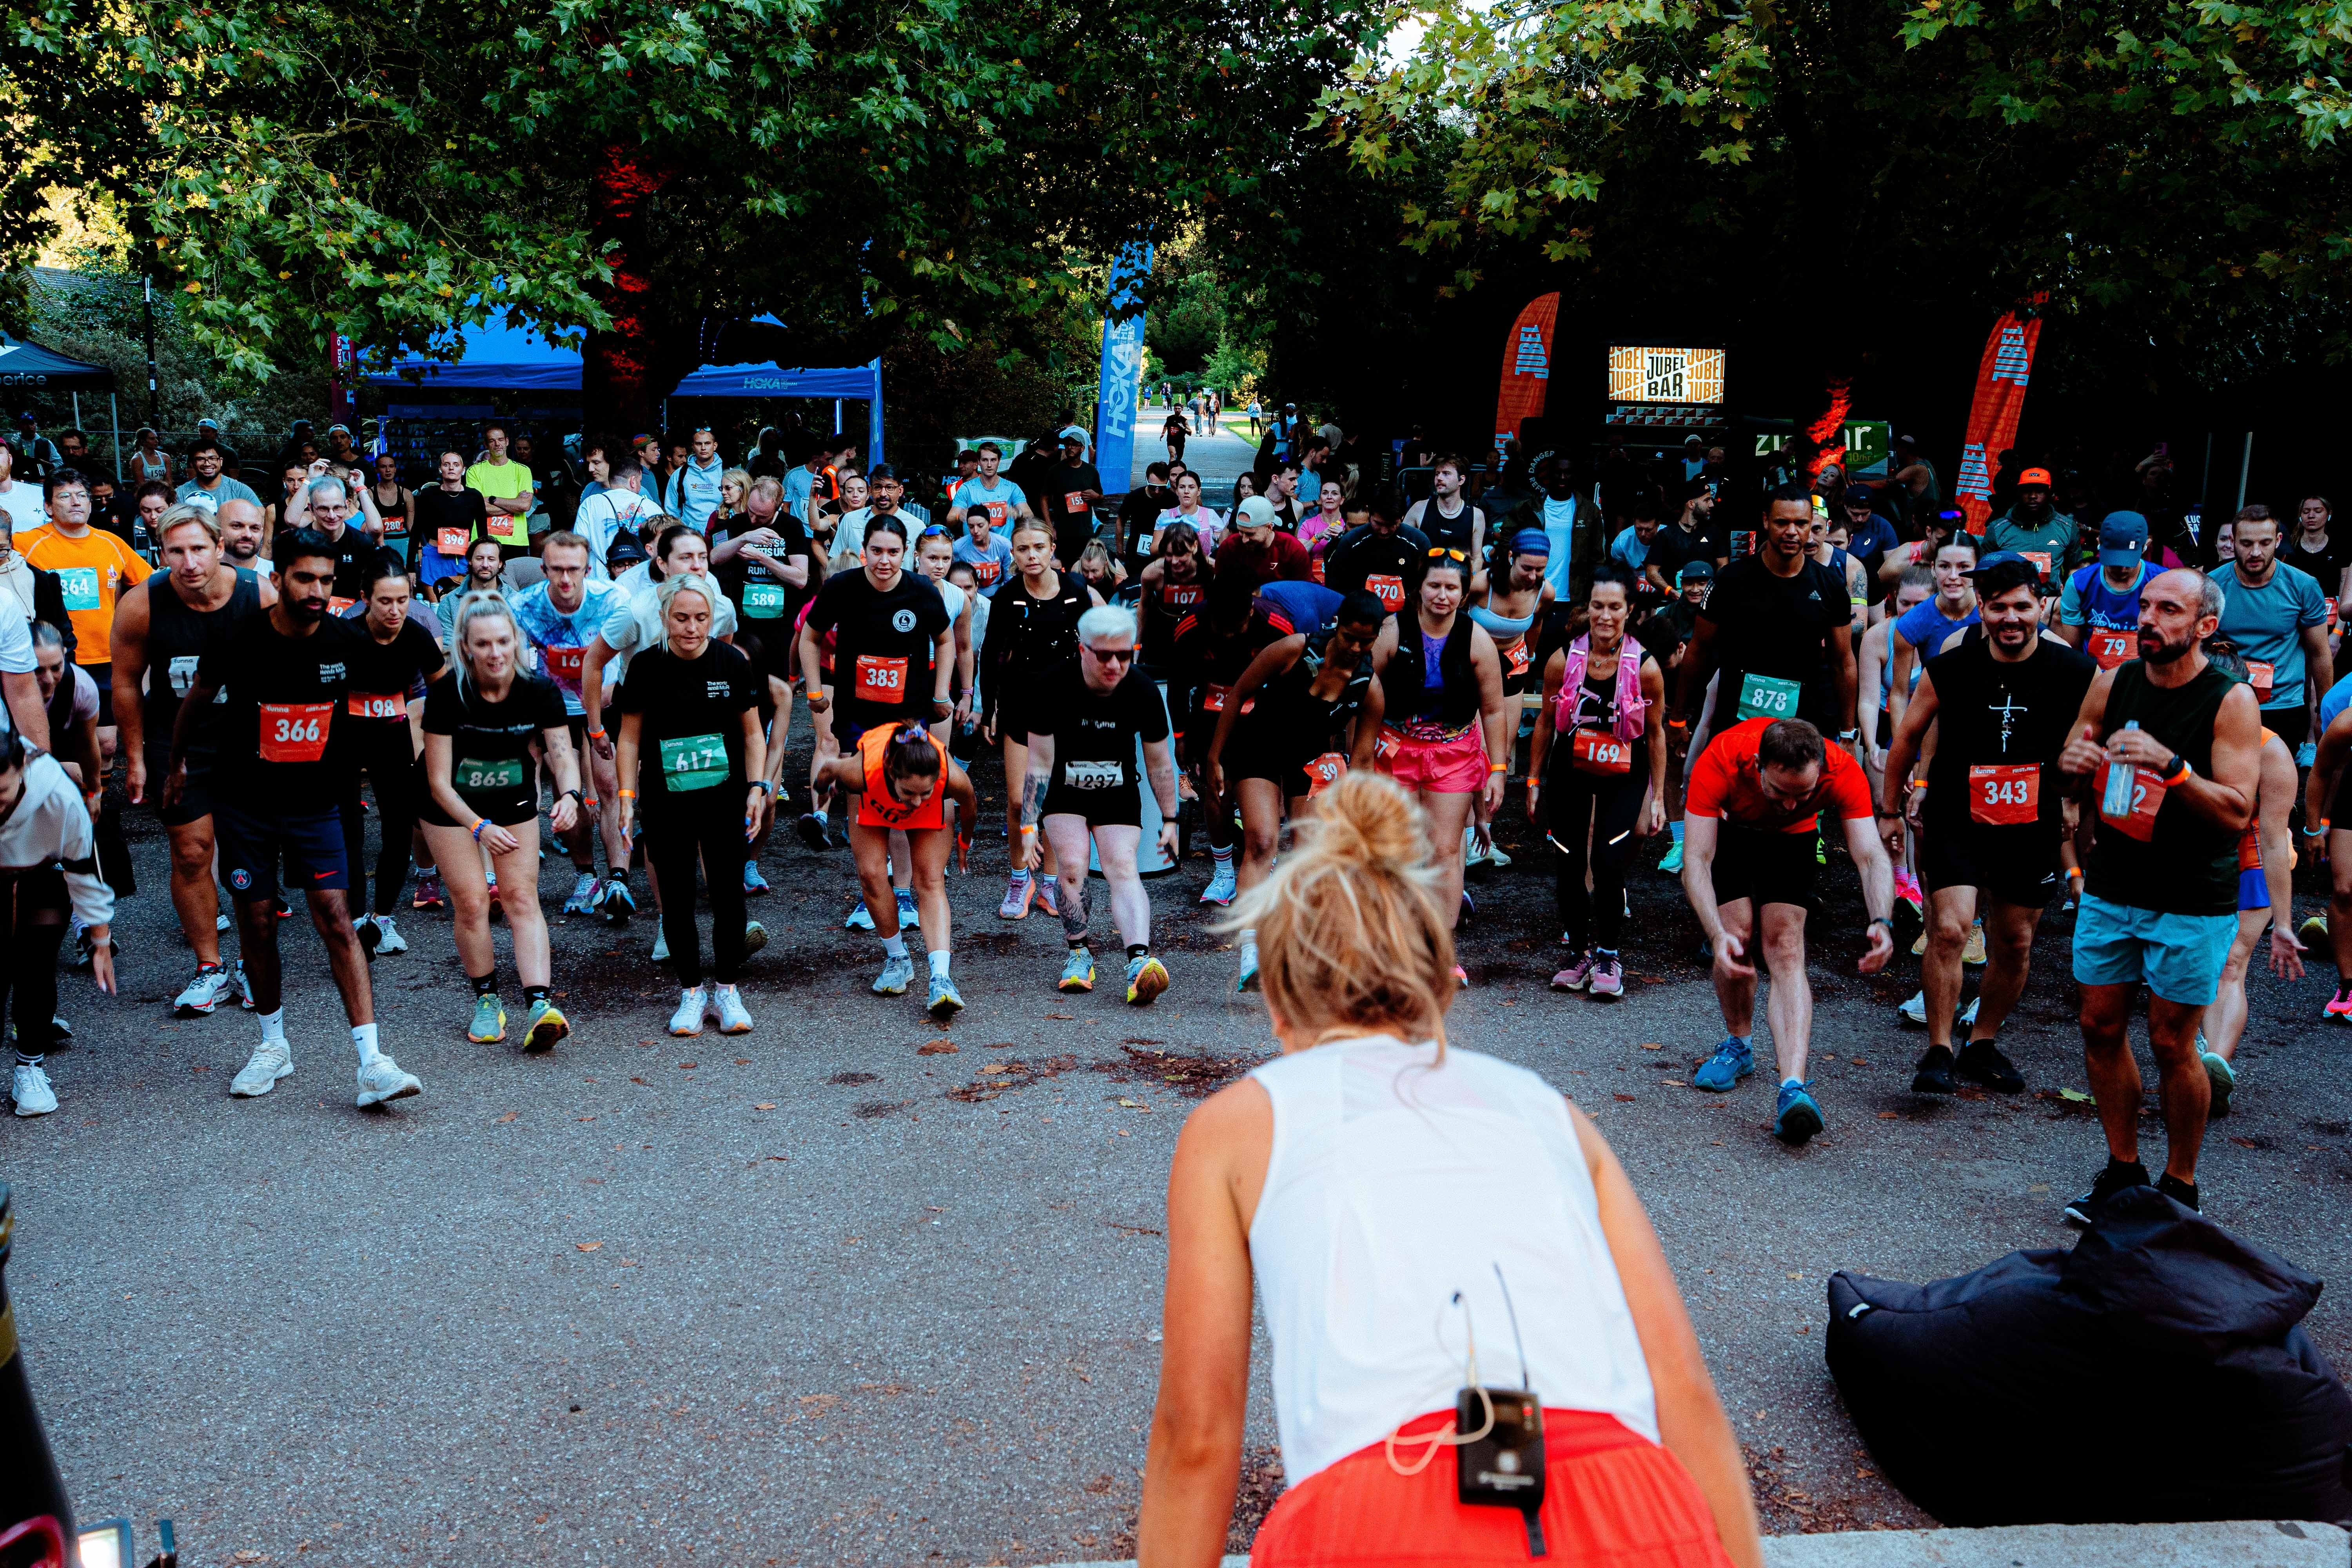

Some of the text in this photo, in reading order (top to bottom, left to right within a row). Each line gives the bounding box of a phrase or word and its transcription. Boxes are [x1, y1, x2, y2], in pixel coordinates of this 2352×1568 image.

[1515, 325, 1549, 379] JUBEL
[1992, 326, 2029, 386] JUBEL
[1647, 356, 1685, 380] JUBEL
[1687, 356, 1724, 379] JUBEL
[744, 377, 779, 389] HOKA
[1105, 339, 1134, 437] HOKA
[1648, 372, 1682, 397] BAR
[1956, 442, 1991, 501] JUBEL
[1071, 496, 1083, 505] 155
[385, 521, 401, 531] 280
[491, 516, 508, 527] 274
[445, 534, 464, 545] 396
[774, 547, 786, 557] UK
[751, 593, 776, 607] 589
[1174, 592, 1196, 604] 107
[1374, 584, 1398, 599] 370
[2104, 639, 2126, 656] 79
[866, 668, 898, 687] 383
[364, 700, 396, 717] 198
[1752, 688, 1787, 711] 878
[274, 719, 319, 742] 366
[676, 749, 712, 771] 617
[1588, 742, 1619, 762] 169
[469, 771, 509, 786] 865
[1074, 774, 1117, 789] 1237
[1985, 780, 2027, 805] 343
